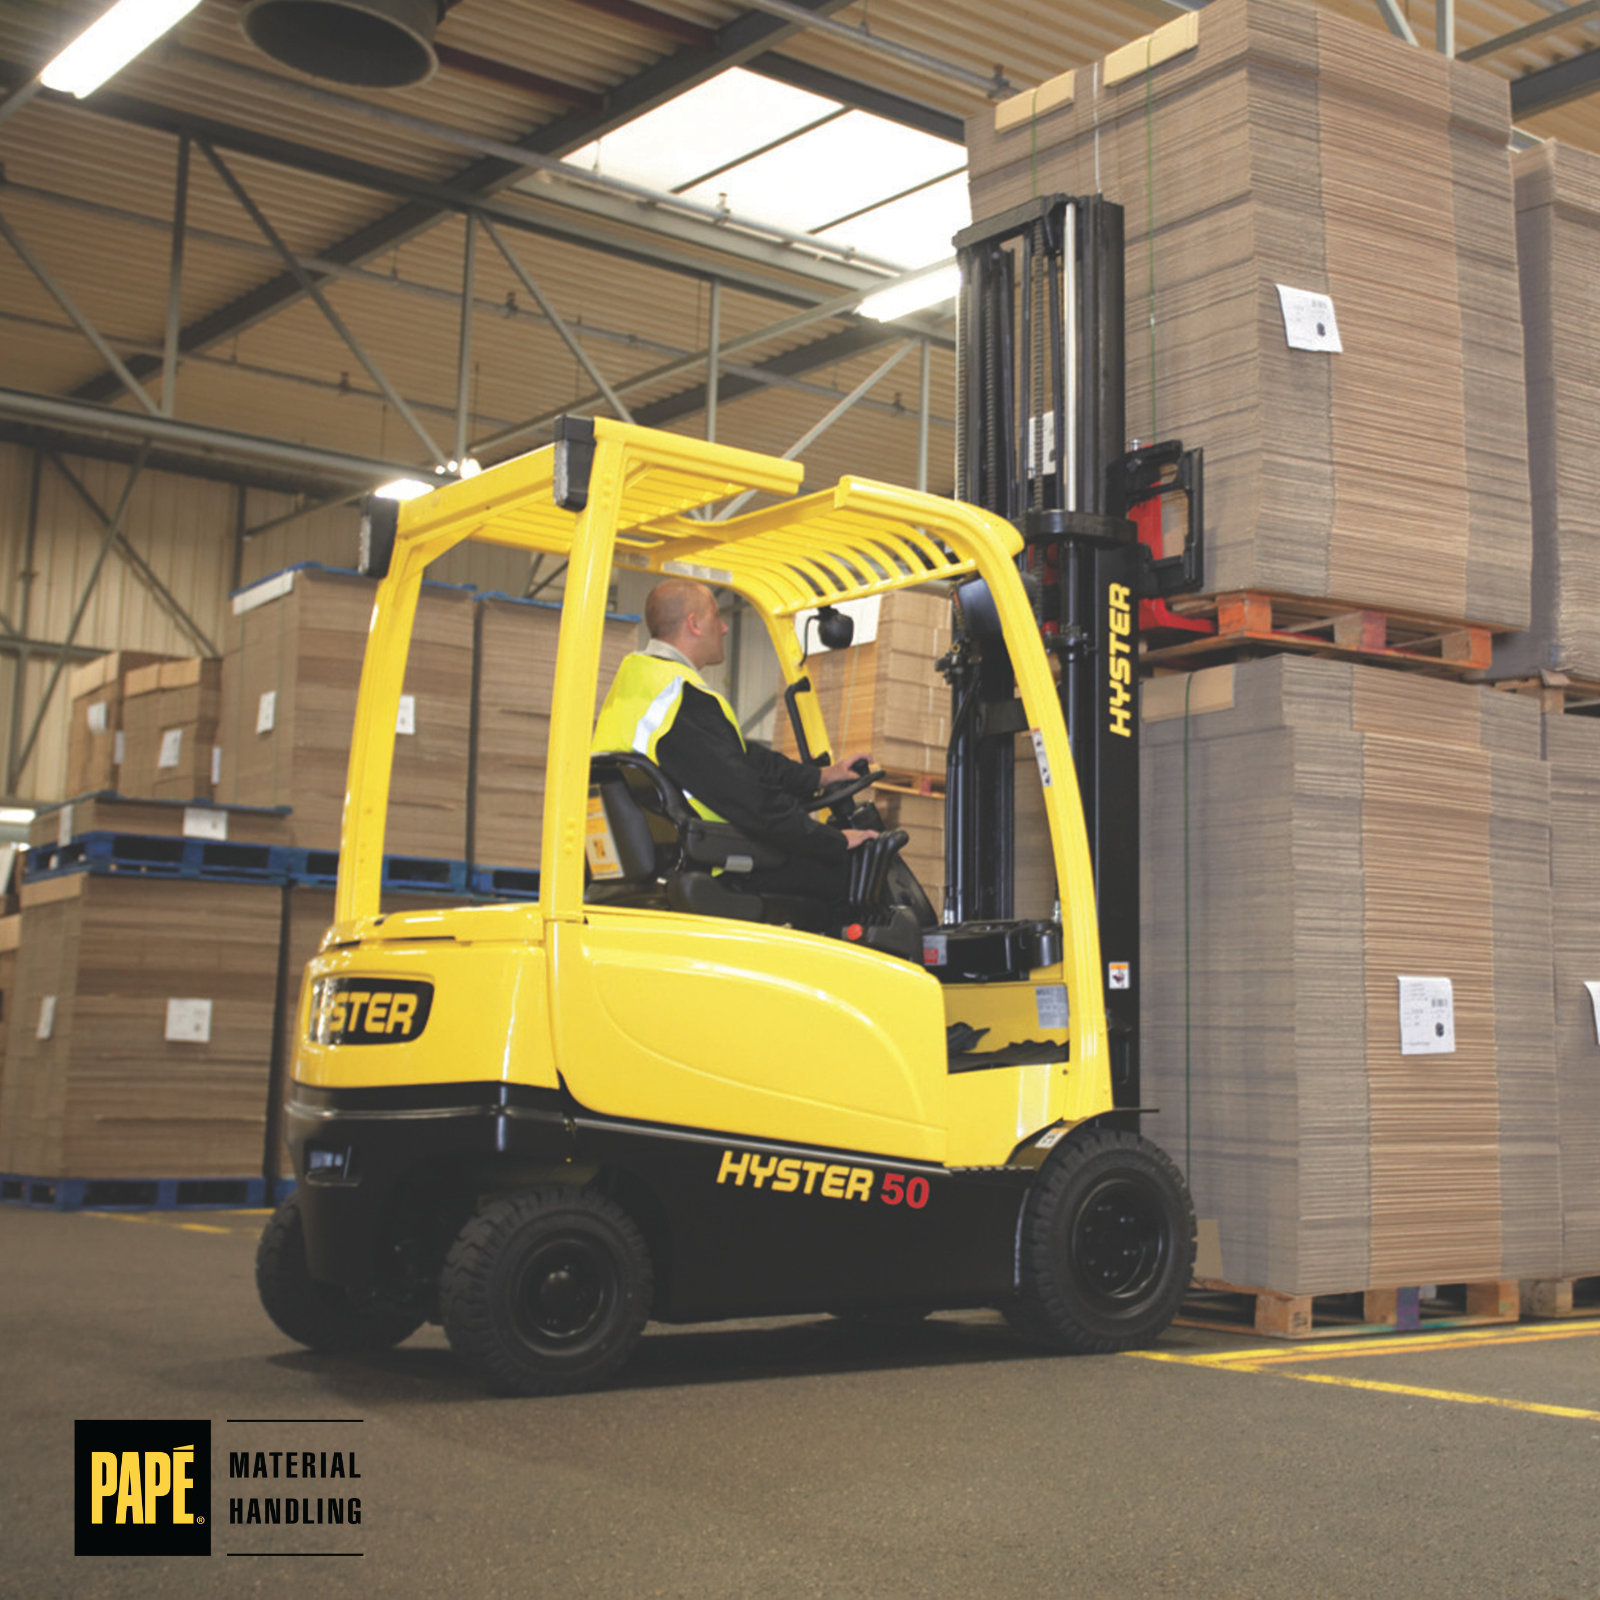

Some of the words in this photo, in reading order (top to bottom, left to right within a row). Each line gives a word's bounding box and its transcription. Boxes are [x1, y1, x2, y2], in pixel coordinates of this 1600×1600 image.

[1109, 582, 1132, 738] HYSTER
[716, 1150, 874, 1202] HYSTER
[880, 1172, 930, 1209] 50
